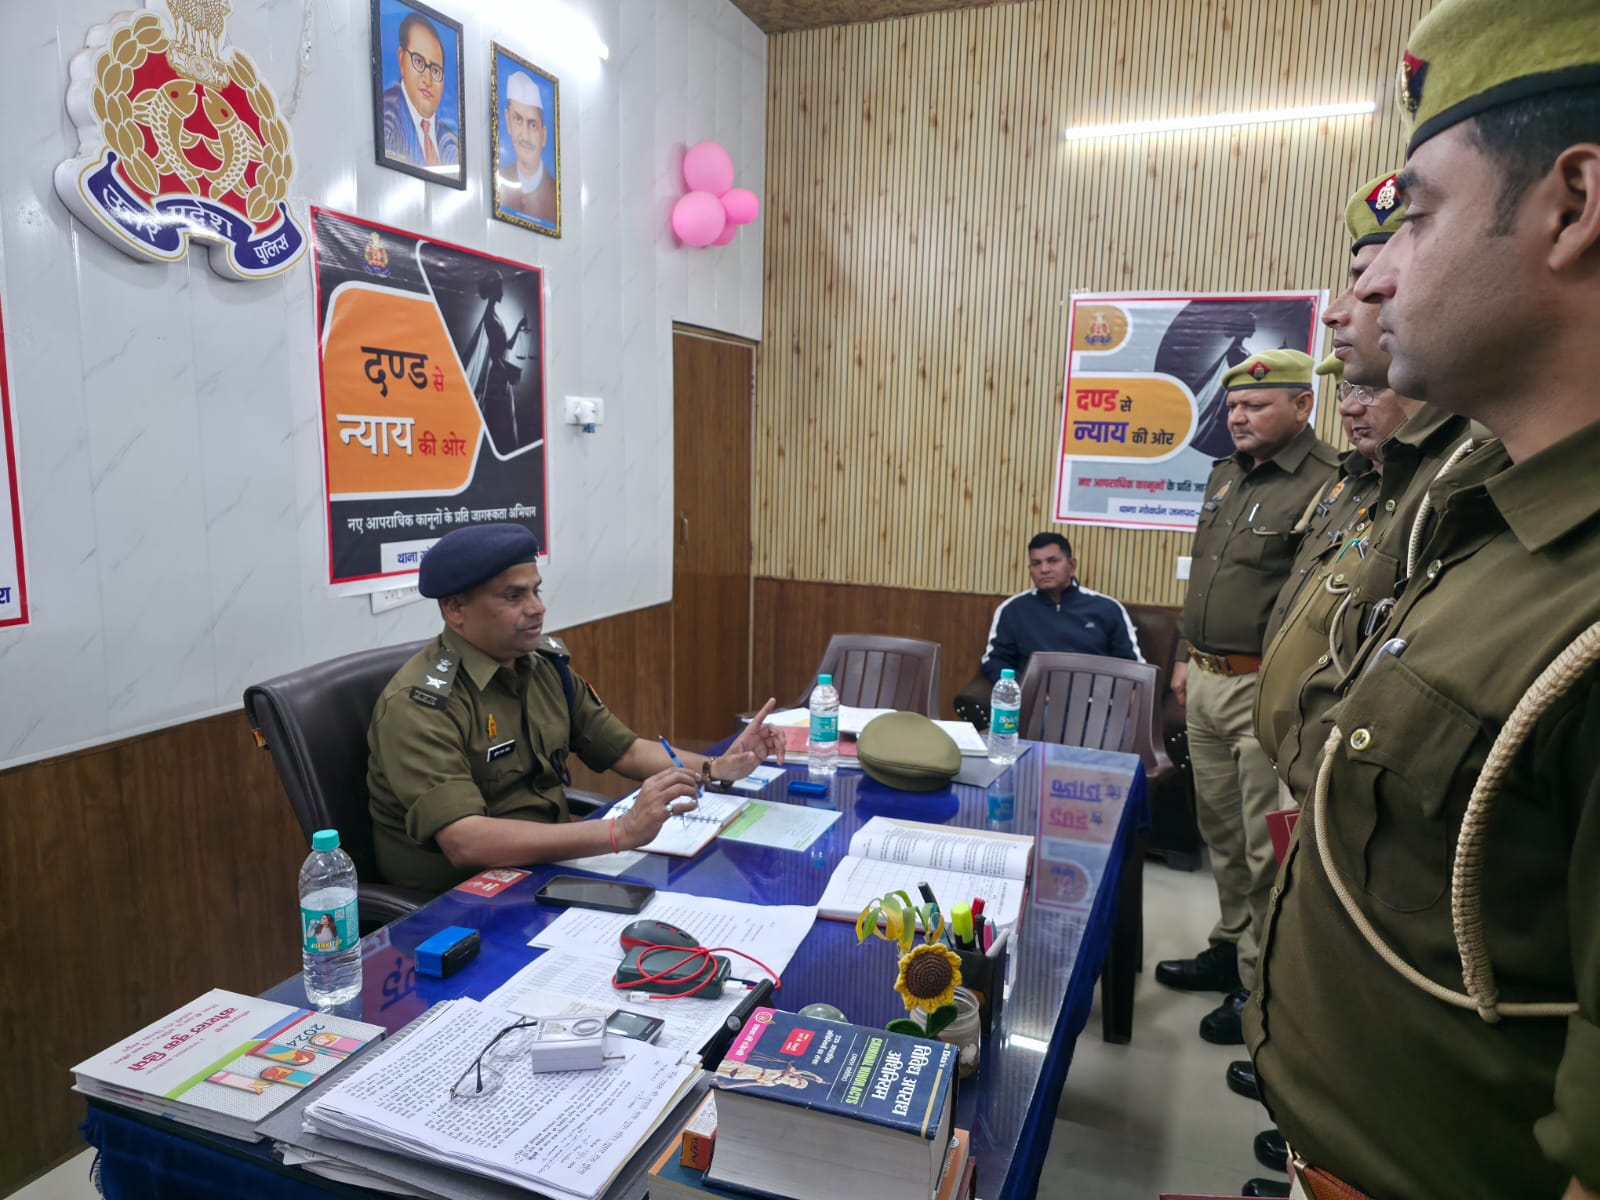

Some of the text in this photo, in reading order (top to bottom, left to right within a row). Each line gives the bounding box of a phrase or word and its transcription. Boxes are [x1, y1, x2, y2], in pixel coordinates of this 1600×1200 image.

[254, 233, 290, 264] पुलिस
[361, 346, 445, 398] दण्ड से
[1076, 390, 1132, 412] दण्ड से
[336, 414, 466, 456] न्याय की ओर
[1073, 421, 1175, 445] न्याय की ओर
[1166, 478, 1174, 491] के
[1176, 480, 1192, 492] प्रति
[347, 518, 364, 534] नए
[366, 510, 414, 530] आपराधिक
[416, 508, 442, 530] कानूनों
[444, 507, 452, 523] के
[454, 506, 469, 522] प्रति
[509, 503, 536, 518] अभियान
[397, 551, 418, 564] थाना
[190, 1007, 238, 1034] कौशल
[163, 1033, 192, 1050] बुक
[286, 1024, 325, 1049] 2024
[128, 1051, 166, 1072] डिपो
[846, 1038, 882, 1104] CRIMINAL MINOR ACTS
[872, 1050, 903, 1100] अधिनियम
[892, 1044, 932, 1116] विविध अपराध
